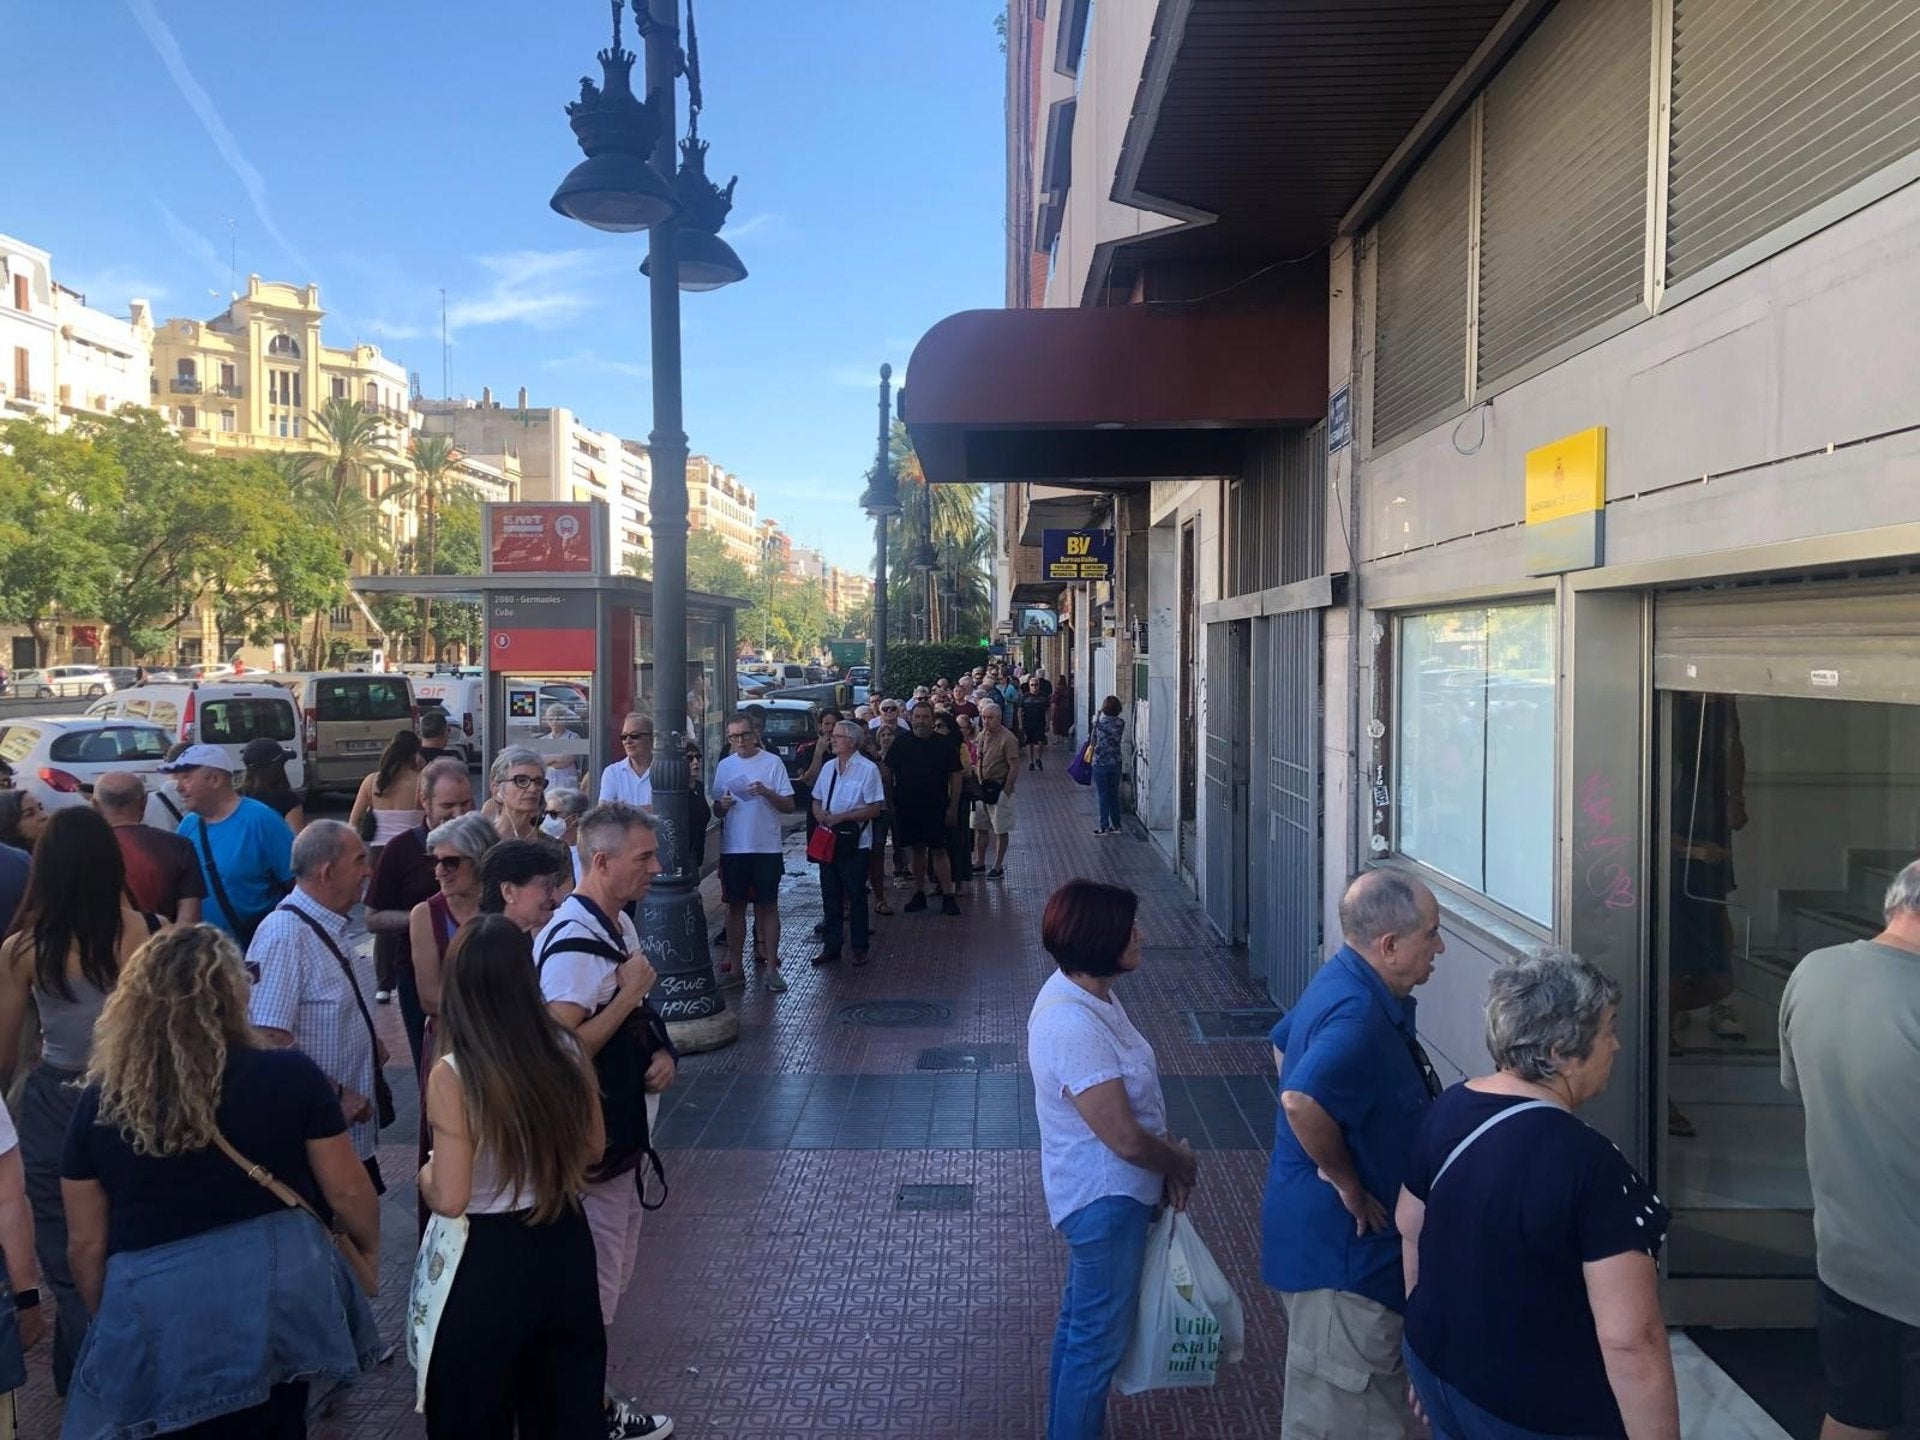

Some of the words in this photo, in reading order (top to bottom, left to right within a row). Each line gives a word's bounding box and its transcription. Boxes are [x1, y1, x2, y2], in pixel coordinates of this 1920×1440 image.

[503, 514, 543, 524] EMT
[1067, 536, 1091, 555] BV
[520, 595, 561, 604] Germanies
[1172, 1341, 1204, 1354] esta
[1169, 1356, 1197, 1371] mil
